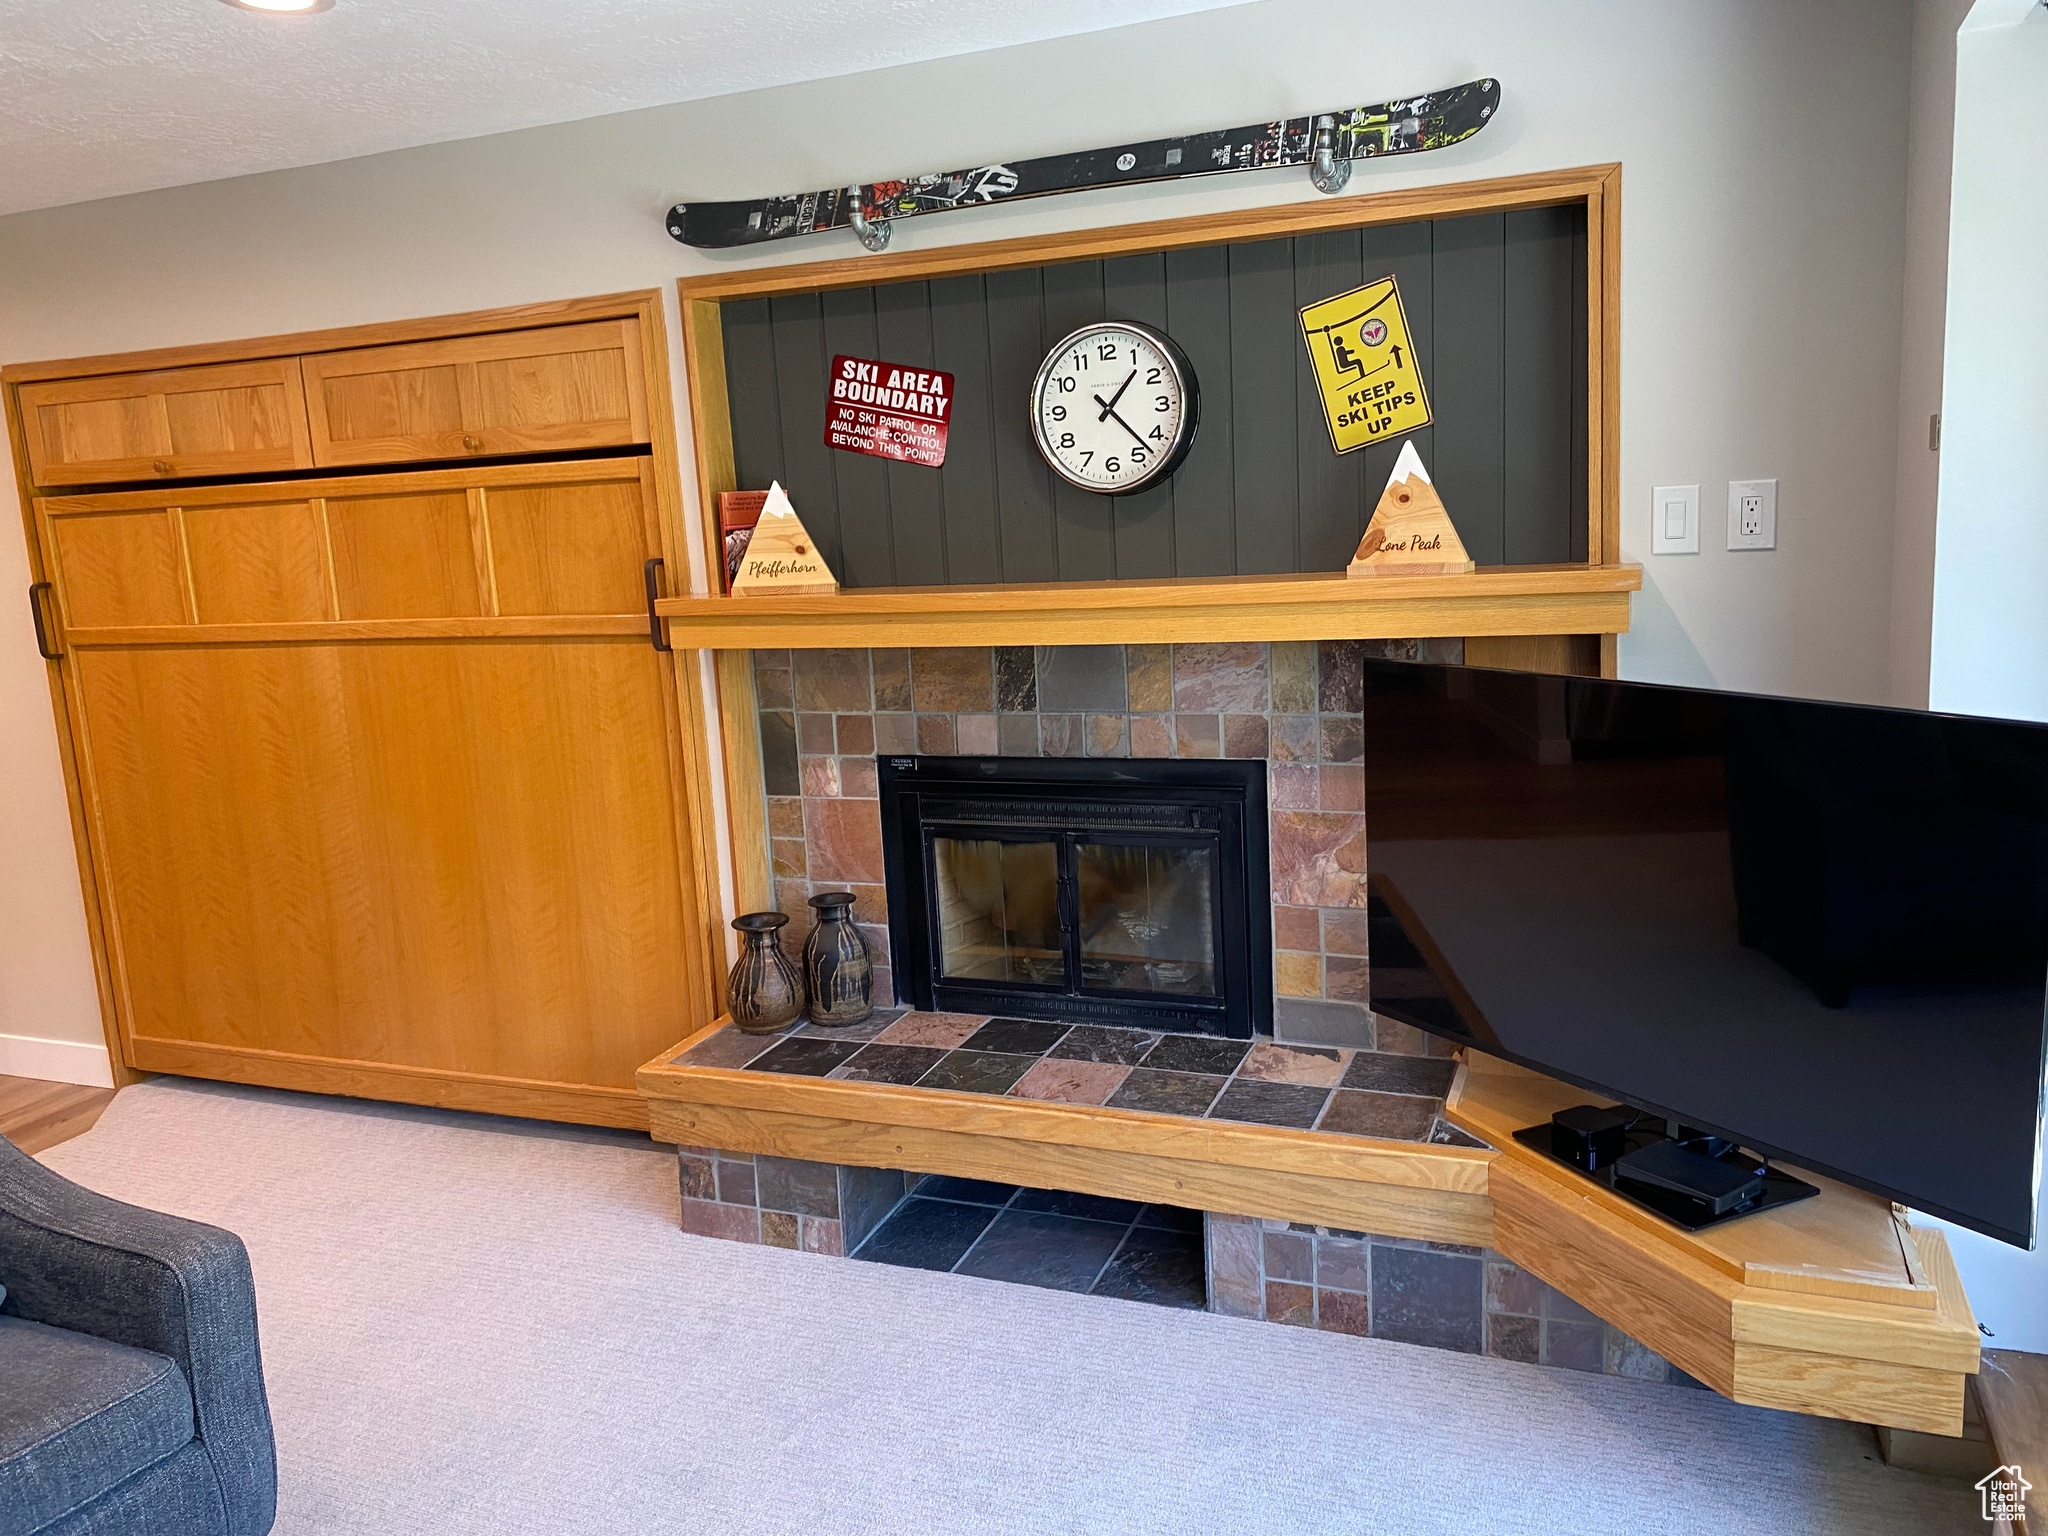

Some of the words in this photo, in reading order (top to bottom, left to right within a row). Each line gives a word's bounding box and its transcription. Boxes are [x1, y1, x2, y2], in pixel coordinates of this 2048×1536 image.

[1097, 344, 1117, 361] 12
[1130, 349, 1137, 365] 1
[1073, 354, 1088, 371] 11
[842, 360, 879, 384] SKI
[887, 369, 944, 395] AREA
[1057, 376, 1076, 393] 10
[1146, 368, 1162, 385] 2
[833, 378, 949, 417] BOUNDARY
[1347, 380, 1396, 407] KEEP
[1154, 396, 1170, 412] 3
[1337, 407, 1369, 428] SKI
[1372, 391, 1416, 416] TIPS
[839, 408, 855, 420] NO
[858, 412, 876, 424] SKI
[879, 415, 917, 432] PATROL
[921, 424, 937, 435] OR
[1052, 405, 1067, 421] 9
[1148, 425, 1164, 441] 4
[1367, 416, 1393, 434] UP
[832, 433, 874, 450] BEYOND
[878, 441, 901, 455] THIS
[1060, 433, 1075, 448] 8
[1079, 451, 1094, 467] 7
[1131, 447, 1146, 463] 5
[1105, 456, 1121, 472] 6
[1376, 536, 1407, 552] Lone
[1410, 534, 1442, 552] Peak
[749, 560, 818, 579] Pfeifferhorn
